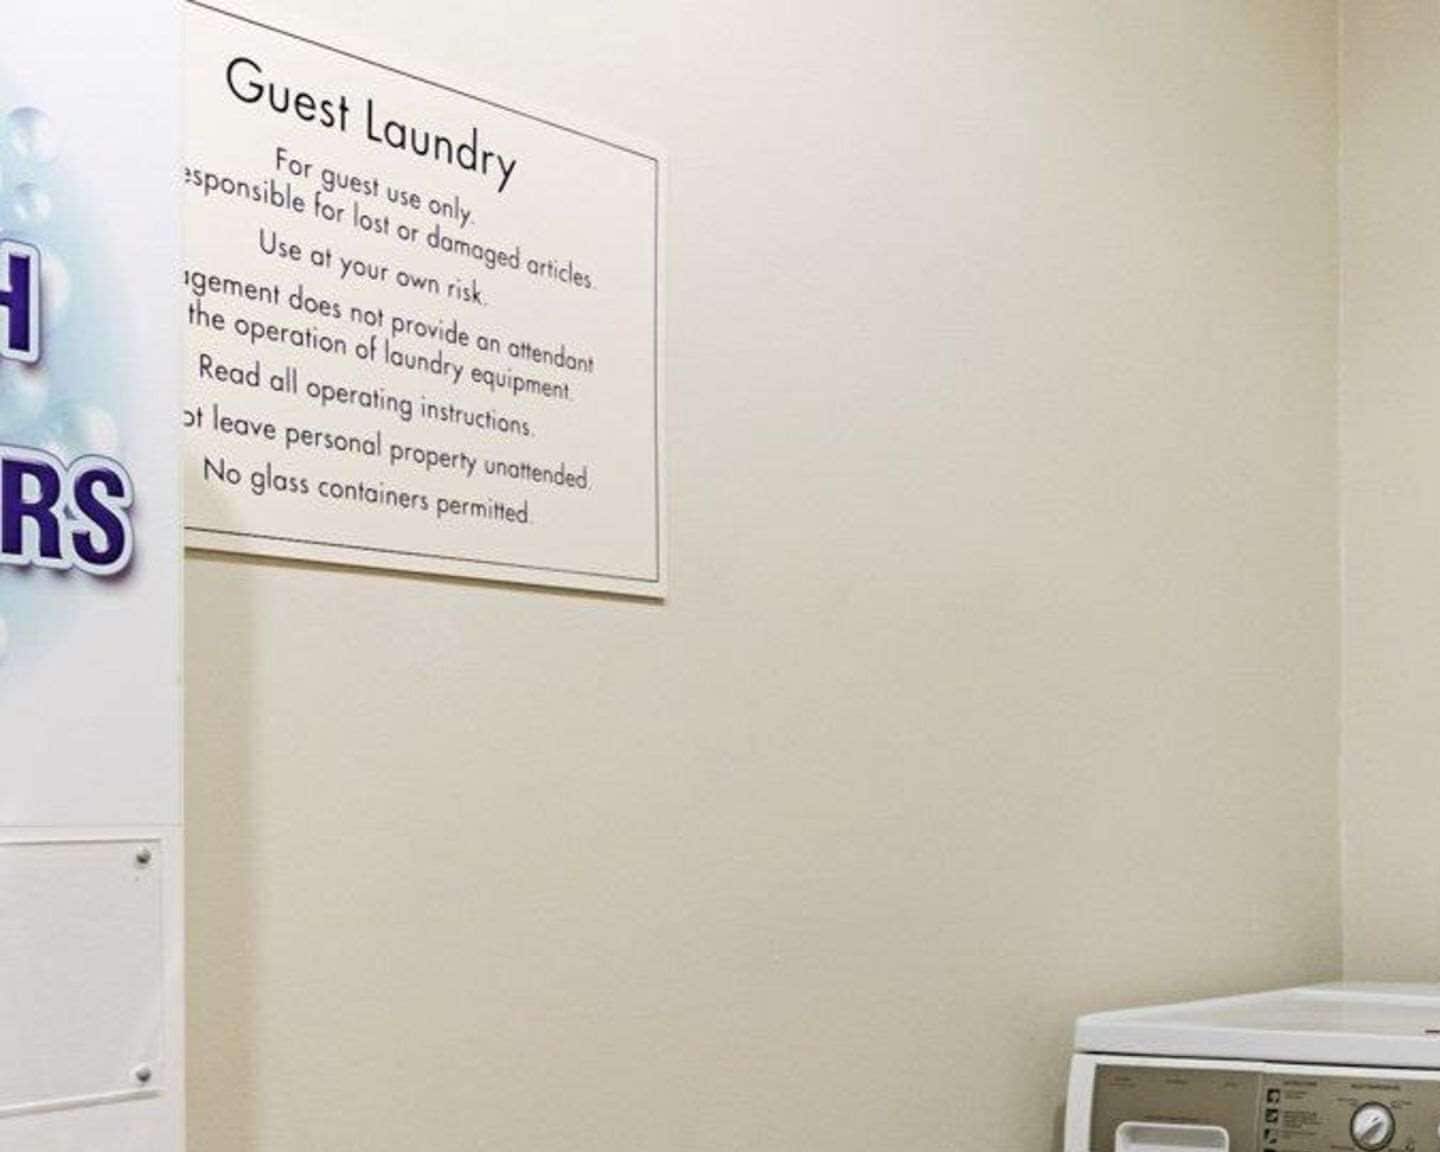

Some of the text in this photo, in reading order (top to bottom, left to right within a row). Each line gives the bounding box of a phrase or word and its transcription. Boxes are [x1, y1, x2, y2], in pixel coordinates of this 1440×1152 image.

[226, 57, 516, 193] Guest Laundry
[276, 146, 475, 228] For guest use only.
[260, 228, 487, 305] Use at your own risk.
[314, 190, 344, 222] for
[354, 202, 389, 234] lost
[397, 225, 419, 242] or
[426, 224, 520, 270] damaged
[188, 298, 224, 330] the
[234, 318, 346, 354] operation
[356, 335, 376, 360] of
[385, 338, 464, 384] laundry
[288, 284, 342, 318] does
[350, 306, 384, 326] not
[392, 317, 469, 346] provide
[476, 336, 500, 353] an
[508, 342, 594, 372] attendant
[200, 353, 260, 387] Read
[270, 366, 297, 394] all
[306, 382, 412, 422] operating
[213, 404, 276, 440] leave
[286, 428, 381, 456] personal
[390, 444, 476, 477] property
[204, 456, 241, 485] No
[250, 462, 309, 496] glass
[318, 482, 428, 510] containers
